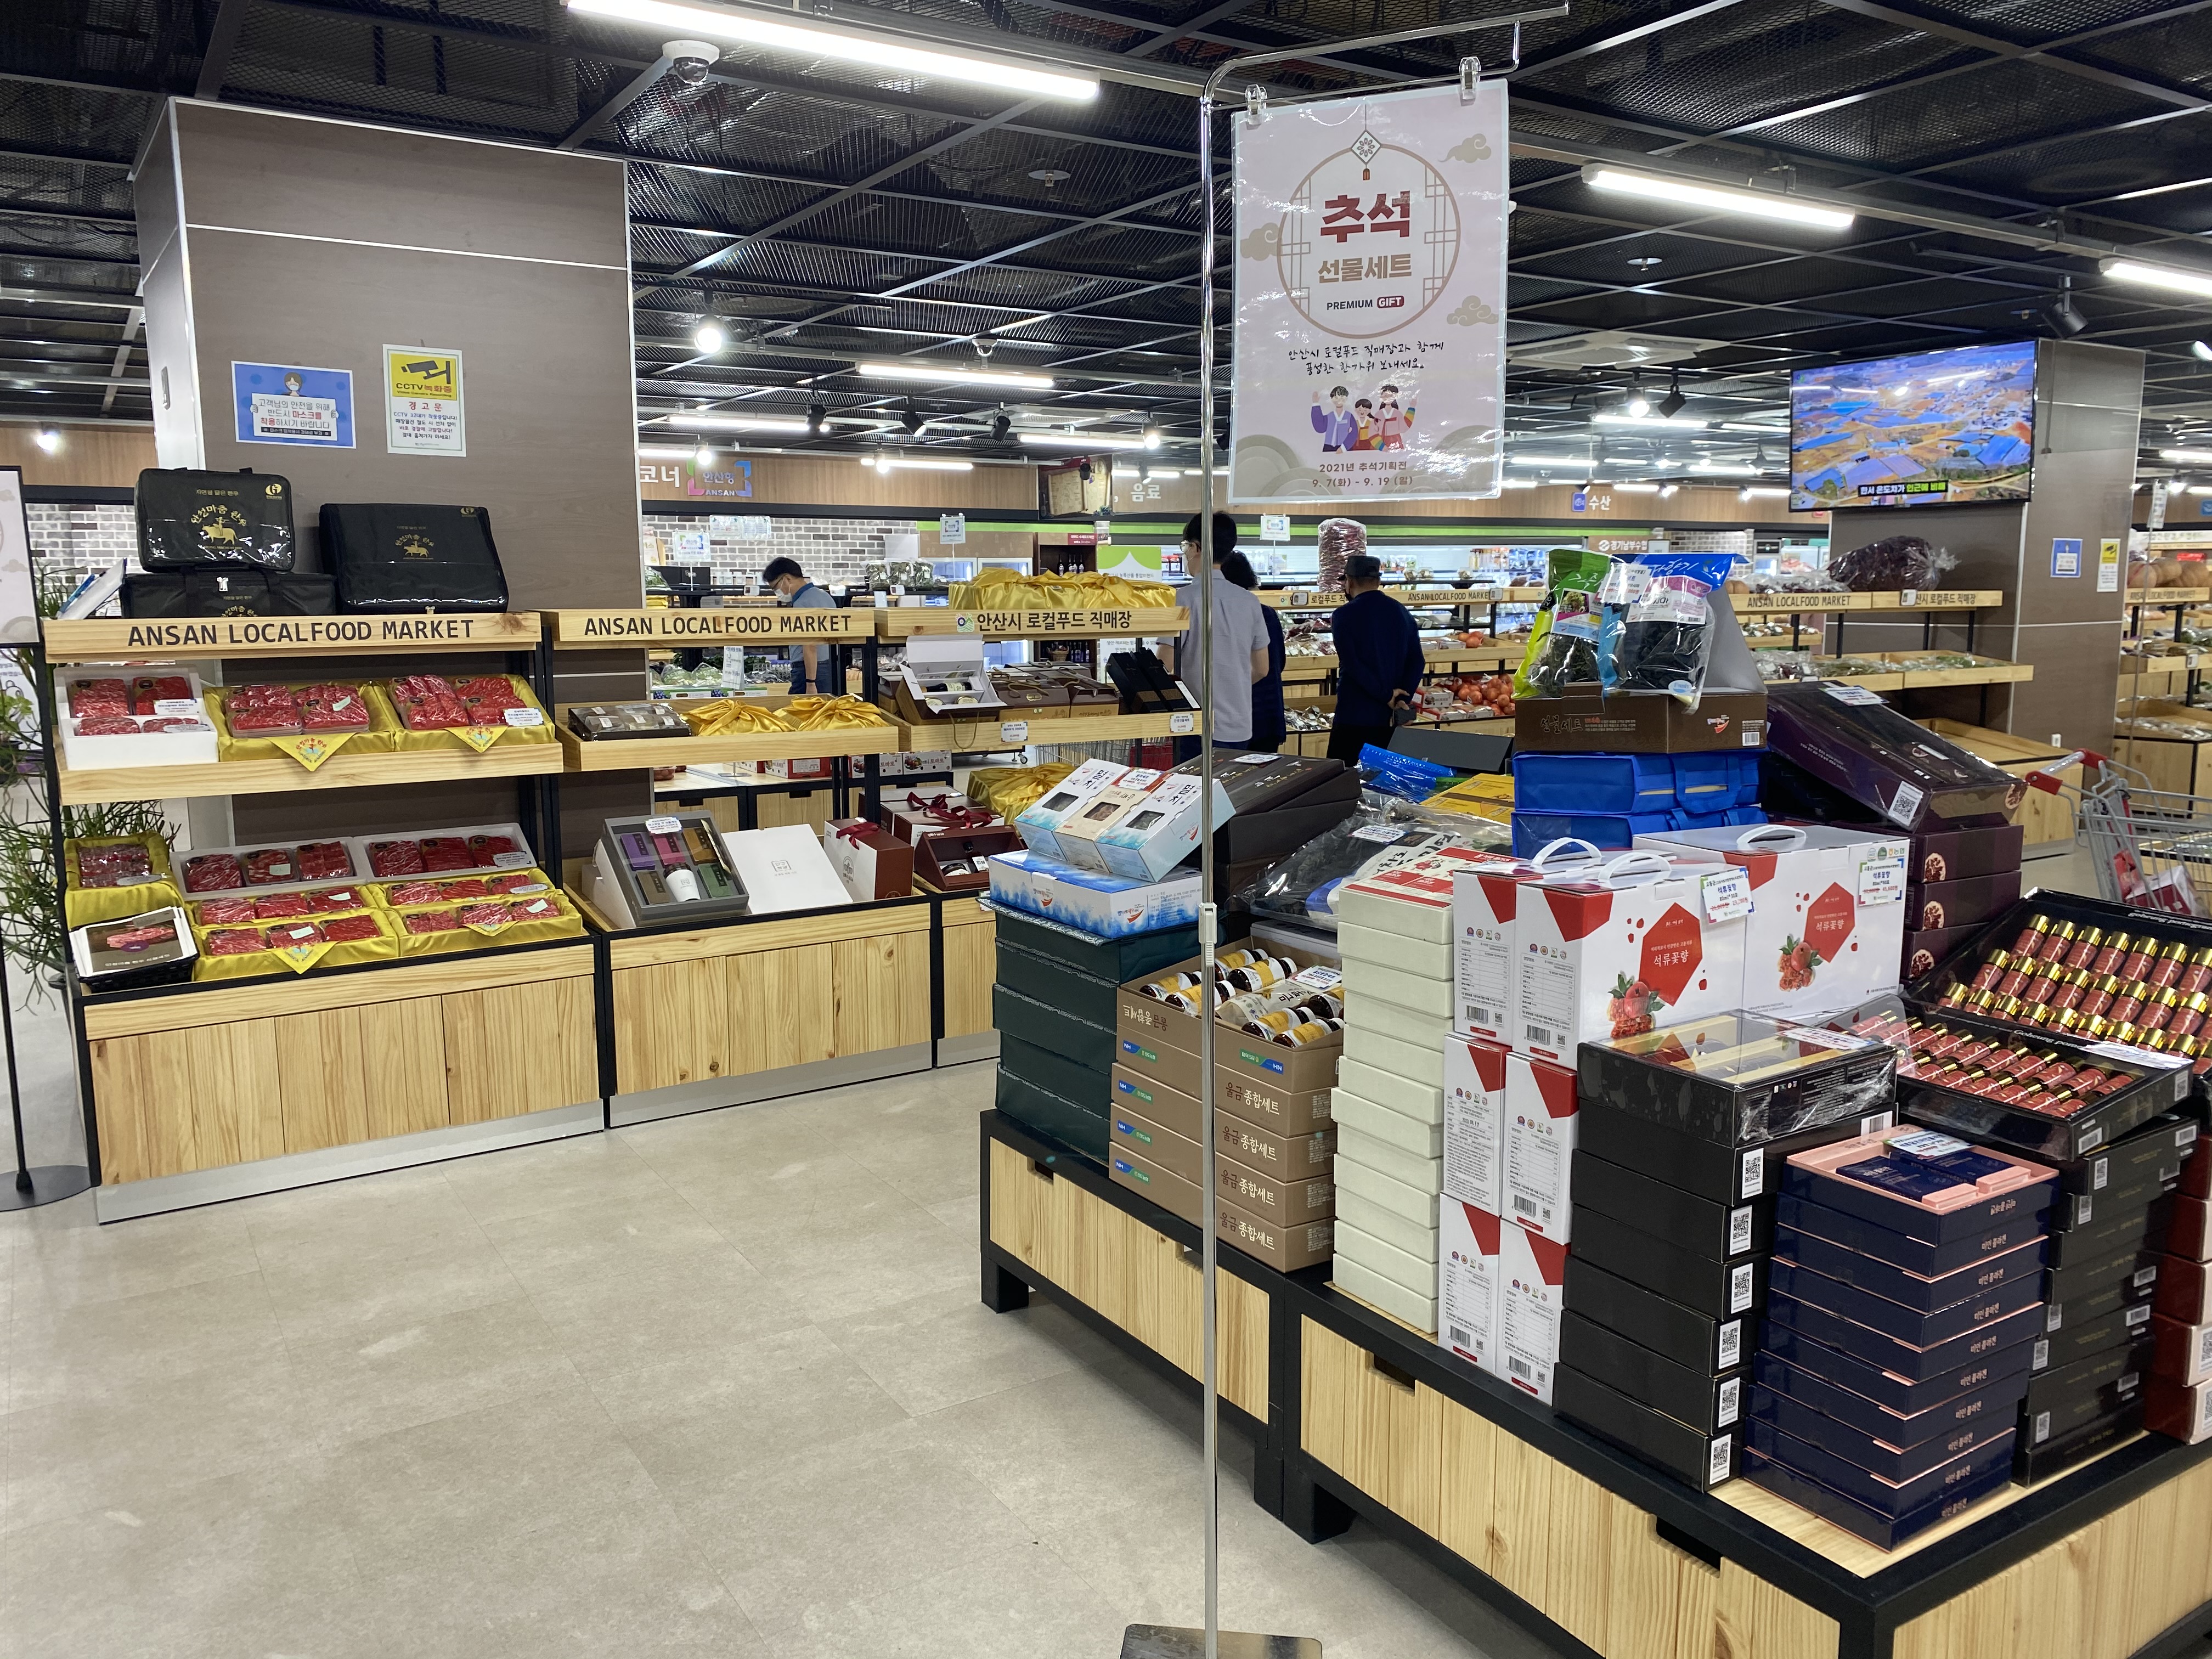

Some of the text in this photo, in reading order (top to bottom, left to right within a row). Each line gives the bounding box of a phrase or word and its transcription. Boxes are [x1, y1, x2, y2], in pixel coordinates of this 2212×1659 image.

[1321, 190, 1410, 243] 추석
[1318, 253, 1412, 284] 선물세트
[1327, 297, 1402, 311] PREMIUM GIFT
[1289, 341, 1444, 360] 안산시 로컬푸드 직매장과 함께
[1306, 362, 1334, 376] 풍성한
[1340, 361, 1374, 374] 한가위
[258, 399, 330, 411] 고객님의 안전을 위해
[261, 417, 330, 429] 착용하시기 바랍니다
[268, 409, 321, 420] 반드시 마스크를
[1319, 461, 1407, 472] 2021년 추석기획전
[640, 465, 680, 488] 코너
[1378, 477, 1390, 486] 19
[1131, 483, 1161, 503] 음료
[1589, 495, 1611, 511] 수산
[1311, 595, 1338, 604] 로컬푸드
[1408, 593, 1429, 601] ANSAN
[1431, 592, 1466, 601] LOCALFOOD
[1747, 595, 1851, 607] ANSAN LOCALFOOD MARKET
[584, 615, 851, 635] ANSAN LOCALFOOD MARKET
[977, 611, 1132, 631] 안산시 로컬푸드 직매장
[128, 619, 474, 647] ANSAN LOCALFOOD MARKET
[1541, 714, 1583, 734] 선물세트
[1718, 884, 1736, 894] 석류꽃향
[1815, 918, 1844, 932] 석류꽃향
[1654, 949, 1689, 967] 석류꽃향
[1226, 1082, 1280, 1115] 울금 종합세트
[1222, 1126, 1277, 1161] 울금 종합세트
[1116, 1161, 1124, 1169] NH
[1221, 1169, 1275, 1206] 울금 종합세트
[1220, 1212, 1275, 1250] 울금 종합세트
